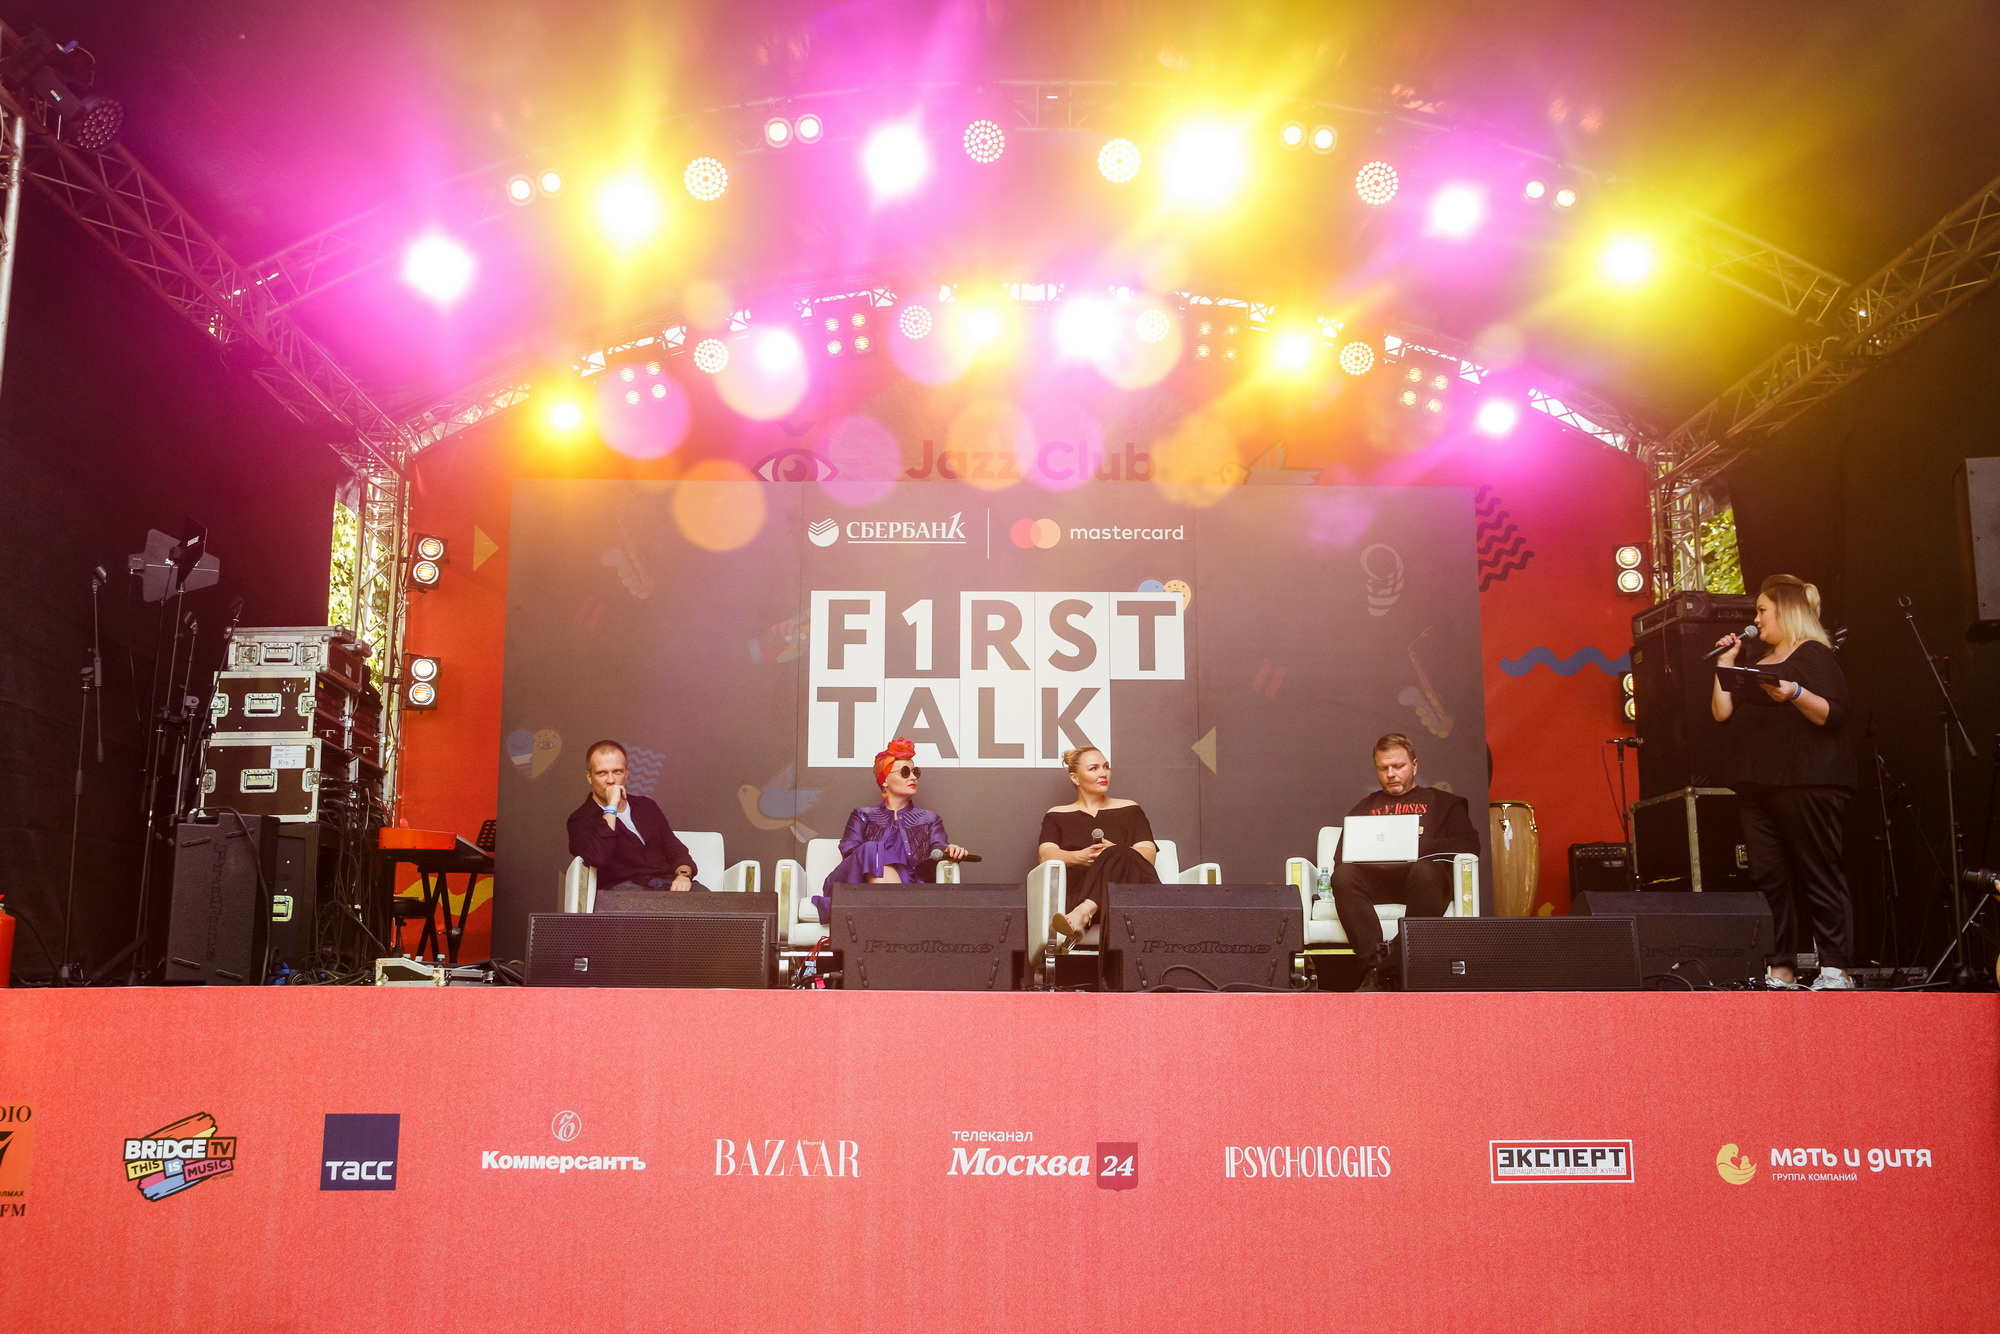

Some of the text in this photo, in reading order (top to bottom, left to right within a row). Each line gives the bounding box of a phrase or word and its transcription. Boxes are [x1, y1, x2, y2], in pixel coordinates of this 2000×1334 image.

[905, 440, 1156, 482] Jazz Club
[1070, 525, 1184, 541] mastercard
[826, 598, 1177, 673] F1RST
[816, 686, 1101, 760] TALK
[863, 941, 994, 953] ProTone
[1142, 941, 1272, 954] ProTone
[952, 1131, 1033, 1142] телеканал
[211, 1141, 231, 1156] TV
[482, 1151, 647, 1174] Коммерсантъ
[713, 1138, 862, 1178] BAZAAR
[947, 1147, 1135, 1177] Москва 24
[1498, 1149, 1624, 1168] ЭКСПЕРТ
[131, 1160, 160, 1175] THIS
[168, 1161, 180, 1173] IS
[1772, 1172, 1858, 1182] ГРУППА КОМПАНИЙ
